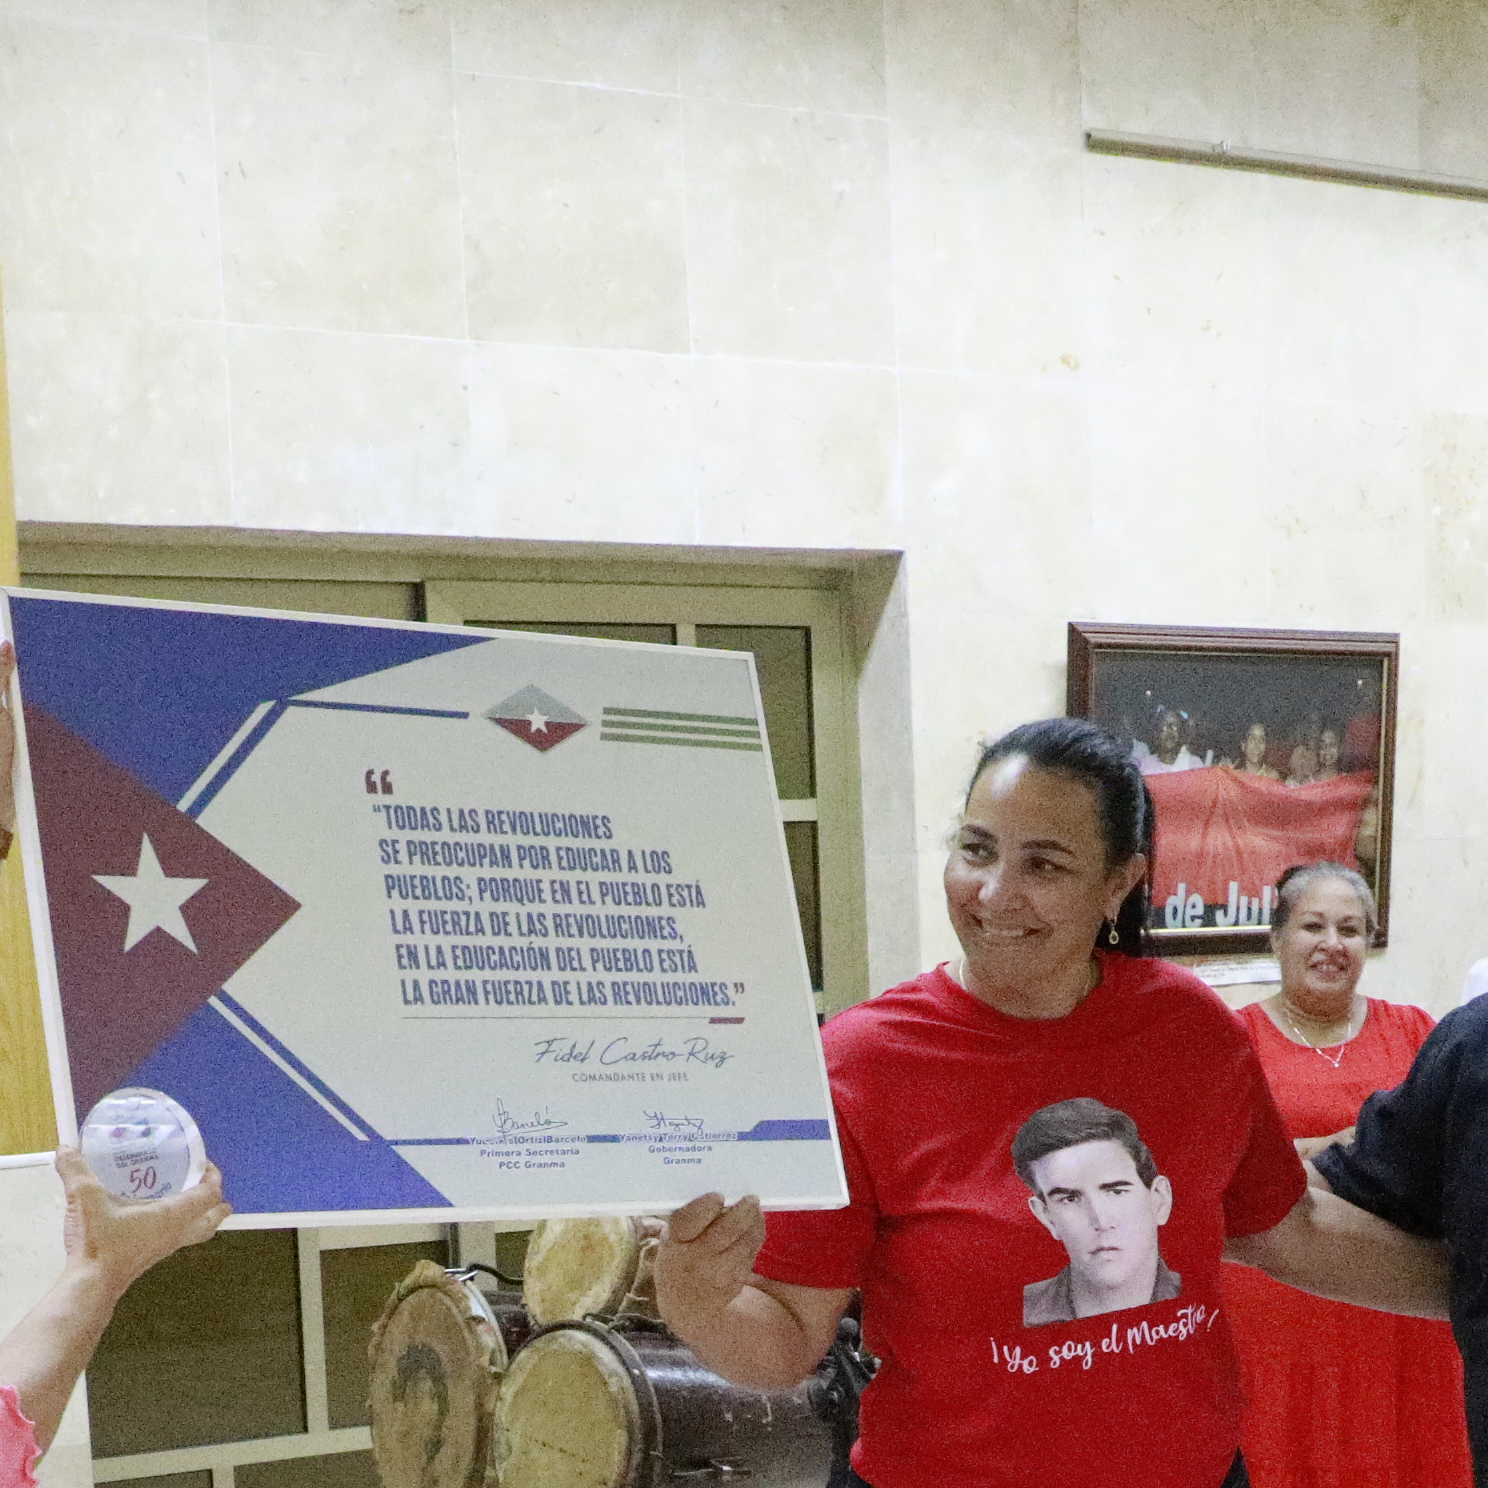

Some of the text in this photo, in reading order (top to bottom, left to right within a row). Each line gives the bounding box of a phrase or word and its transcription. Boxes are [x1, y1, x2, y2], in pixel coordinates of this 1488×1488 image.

[446, 807, 481, 834] LAS
[485, 809, 613, 840] REVOLUCIONES
[379, 838, 673, 875] SE PREOCUPAN POR EDUCAR A LOS
[384, 873, 707, 909] PUEBLOS; PORQUE EN EL PUEBLO ESTÁ
[1165, 881, 1279, 929] de Jul
[390, 908, 685, 943] LA FUERZA DE LAS REVOLUCIONES,
[395, 941, 698, 974] EN LA EDUCACIÓN DEL PUEBLO ESTÁ
[400, 978, 425, 1006] LA
[428, 979, 479, 1006] GRAN
[482, 979, 549, 1006] FUERZA
[551, 980, 574, 1006] DE
[576, 980, 608, 1006] LAS
[534, 1036, 735, 1068] Fidel Castro Ruz
[572, 1072, 689, 1082] COMANDANTE EN JEFE
[480, 1148, 580, 1158] Primera Secretaria
[499, 1160, 566, 1170] PCC Granma
[648, 1145, 713, 1154] Gobernadora
[663, 1157, 703, 1165] Granma
[130, 1166, 157, 1194] 50
[1048, 1339, 1095, 1370] soy
[1101, 1324, 1122, 1353] el
